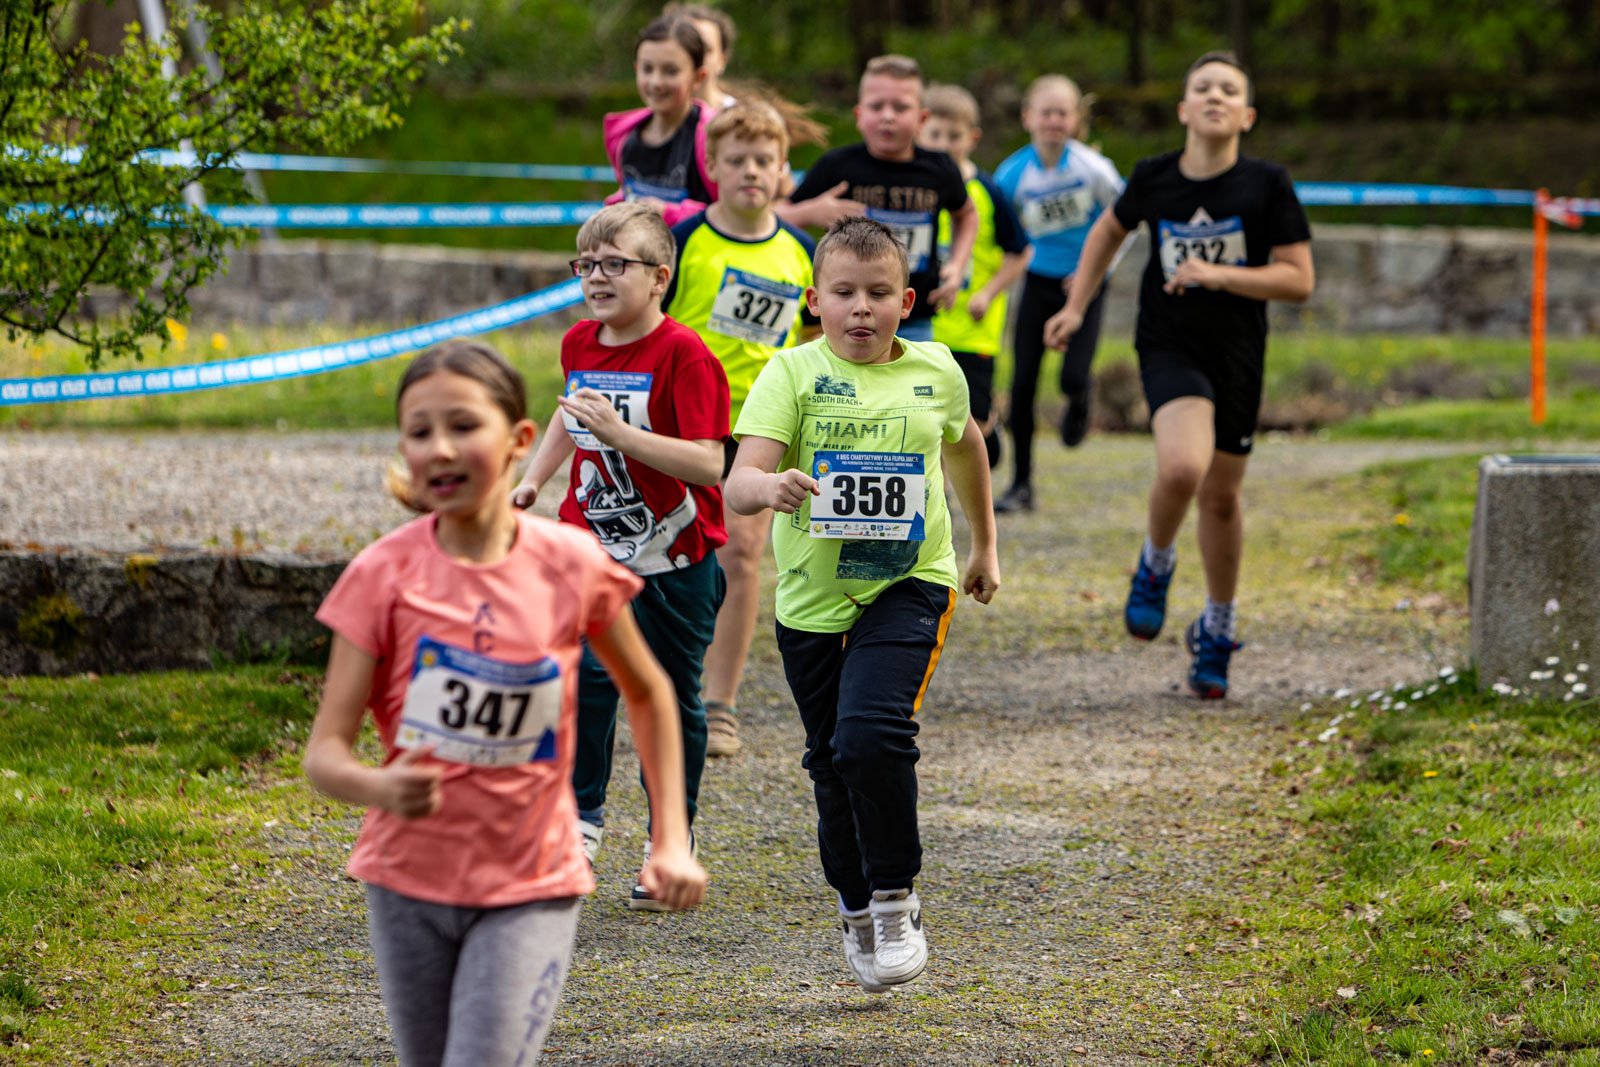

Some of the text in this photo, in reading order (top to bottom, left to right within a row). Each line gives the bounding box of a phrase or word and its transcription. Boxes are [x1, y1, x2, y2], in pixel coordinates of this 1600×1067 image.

[1175, 237, 1226, 265] 332
[734, 291, 784, 327] 327
[812, 396, 859, 406] SOUTH BEACH
[815, 421, 887, 438] MIAMI
[833, 475, 906, 517] 358
[440, 678, 531, 738] 347
